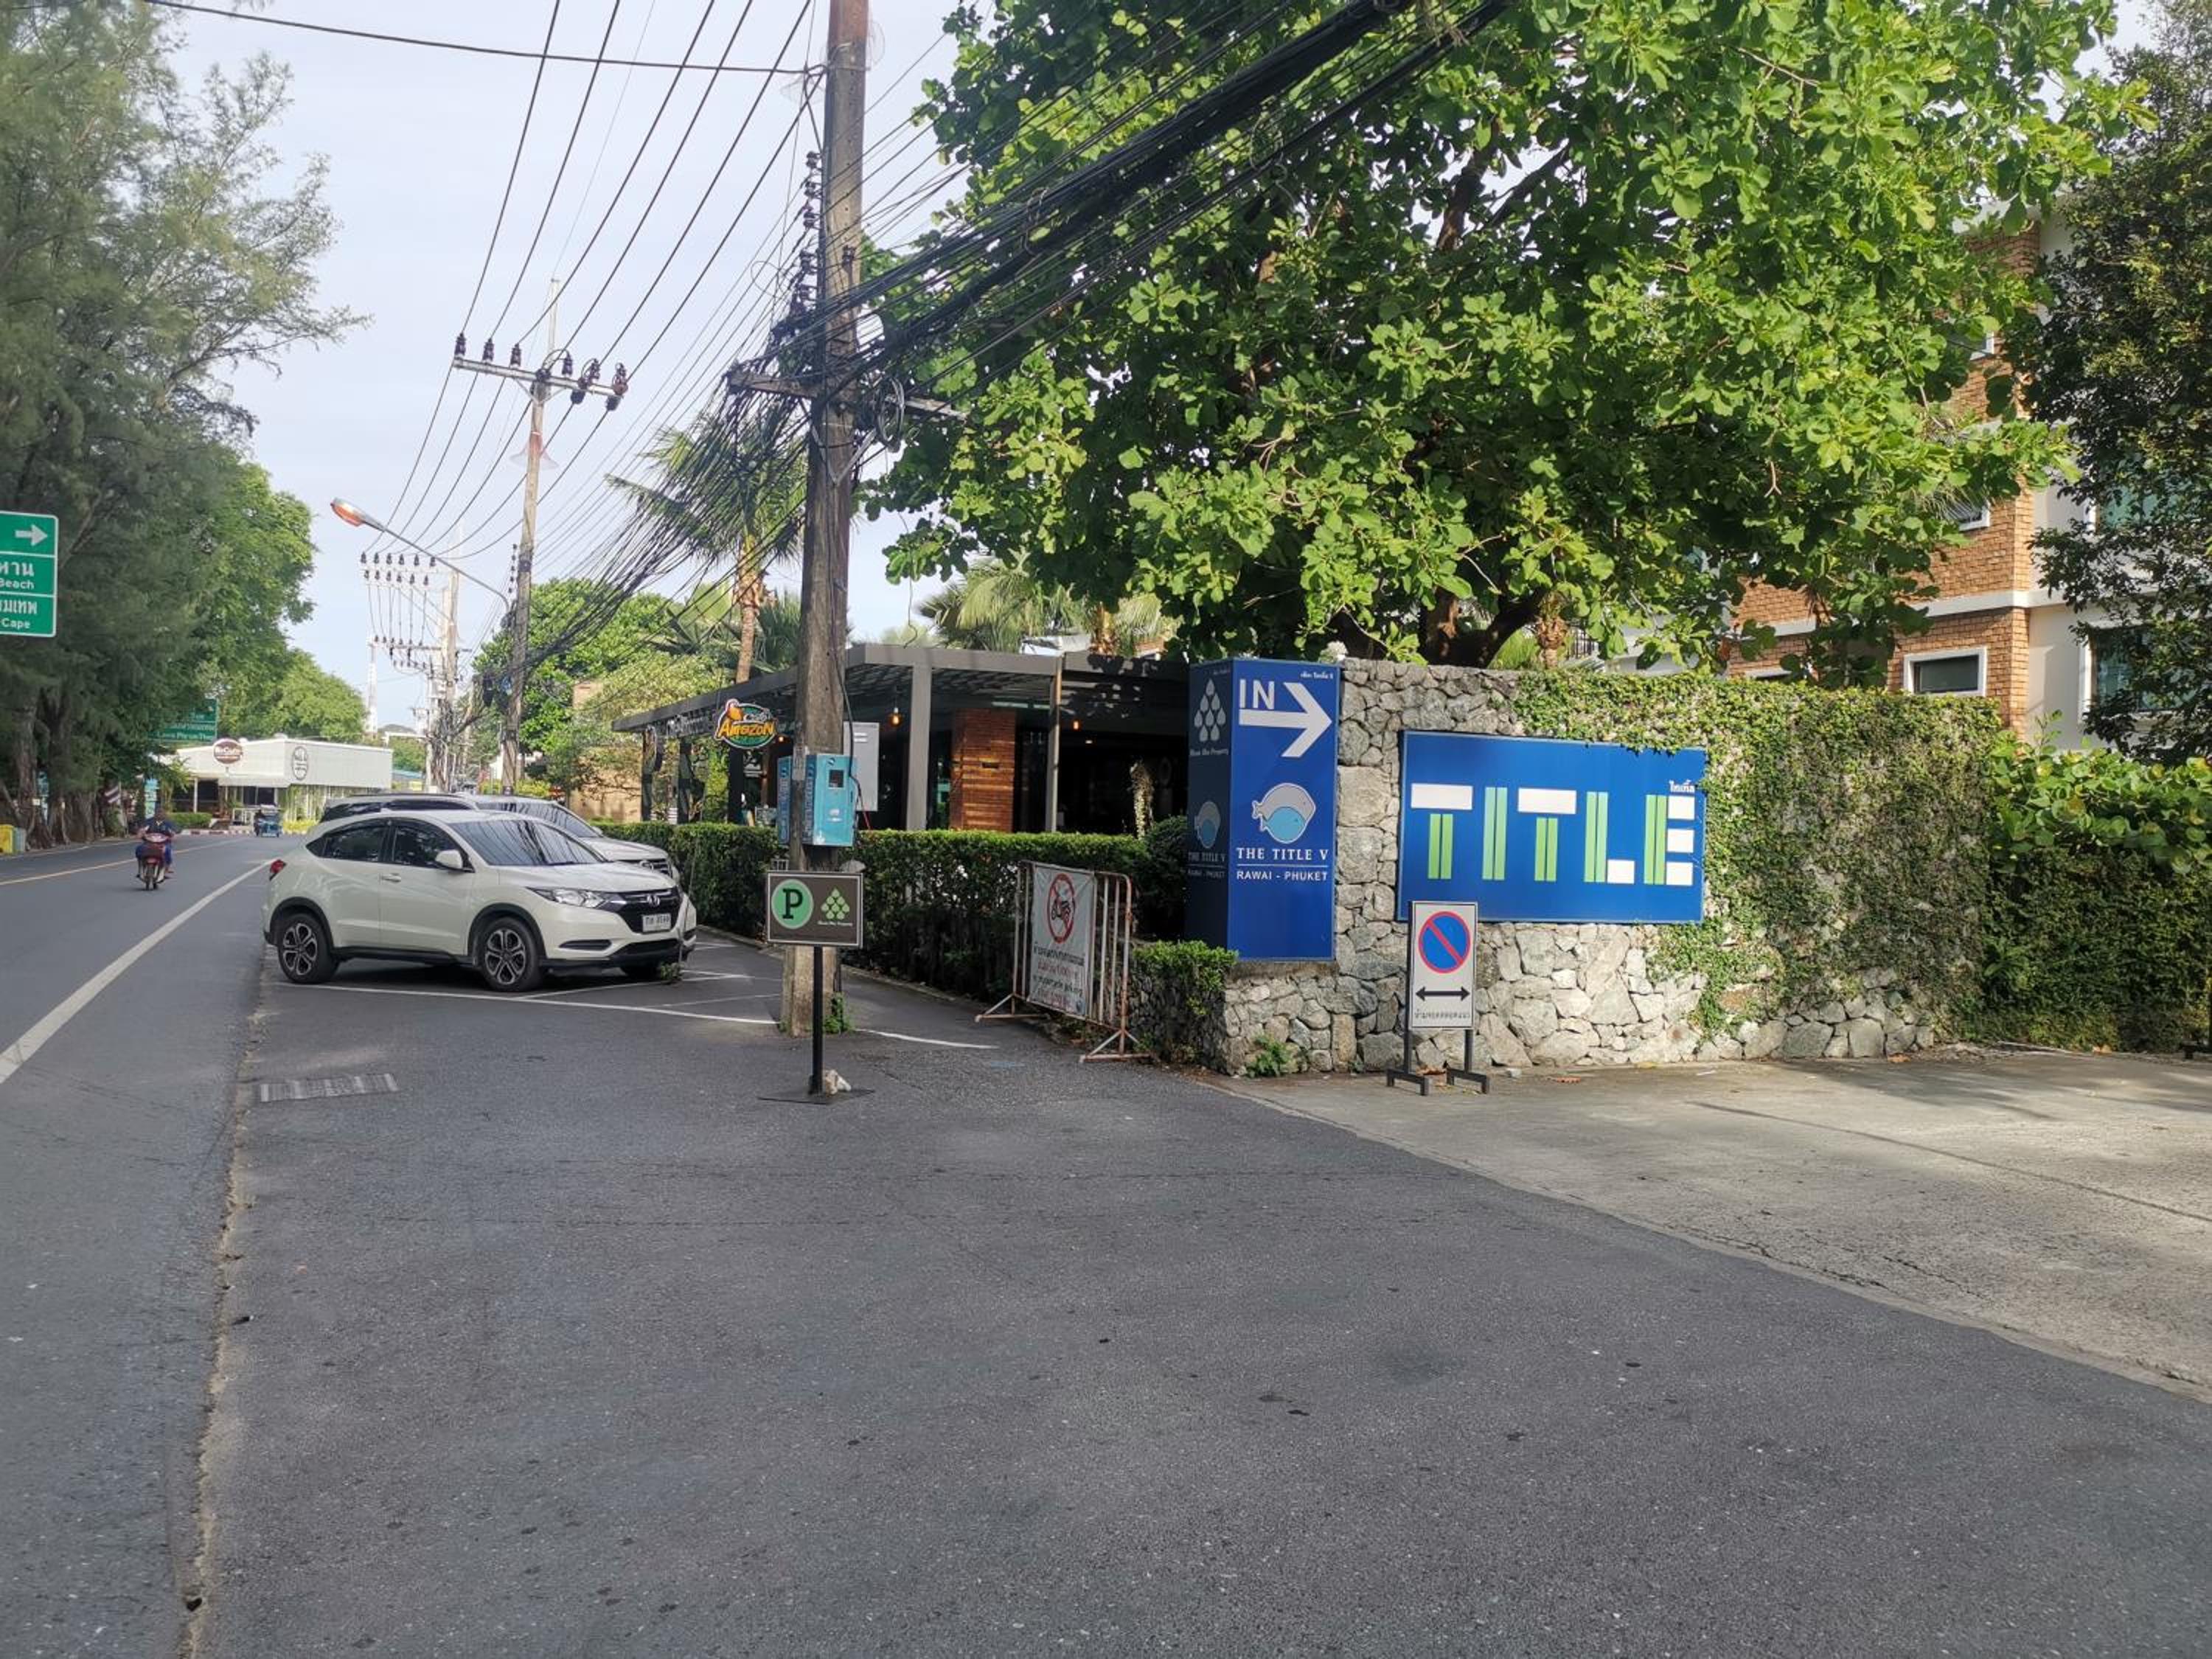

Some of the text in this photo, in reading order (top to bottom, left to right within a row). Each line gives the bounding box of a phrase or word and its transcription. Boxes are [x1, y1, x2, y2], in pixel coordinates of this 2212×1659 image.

[0, 578, 35, 590] Beach
[1, 617, 31, 630] Cape
[1239, 678, 1275, 710] IN
[1411, 783, 1695, 886] TITLE
[1236, 847, 1329, 860] THE TITLE V
[1237, 871, 1272, 880] RAWAI
[1284, 872, 1329, 881] PHUKET
[782, 888, 803, 919] P
